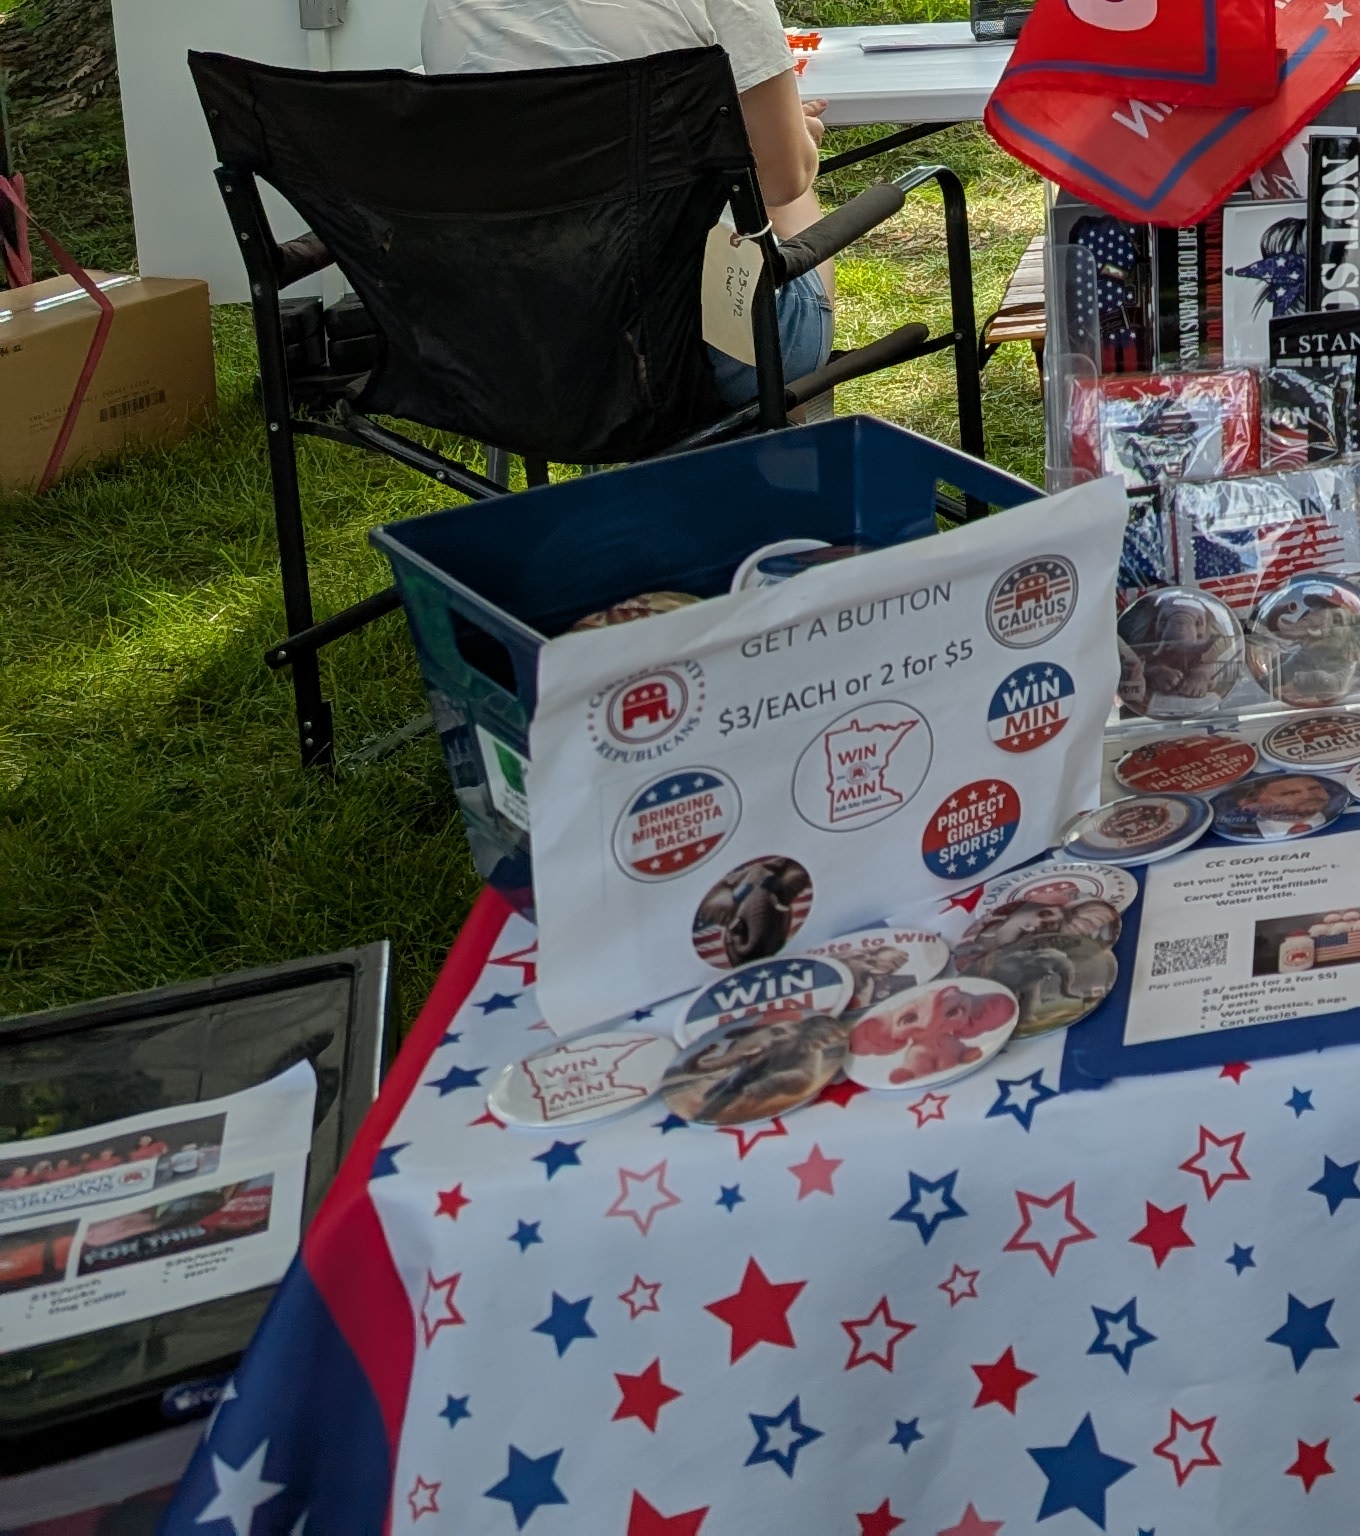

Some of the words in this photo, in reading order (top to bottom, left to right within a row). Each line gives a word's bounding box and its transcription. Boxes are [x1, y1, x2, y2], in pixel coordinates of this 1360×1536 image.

[1279, 336, 1287, 355] I
[741, 624, 799, 658] GET
[808, 617, 827, 642] A
[837, 581, 952, 633] BUTTON
[997, 597, 1067, 632] CAUCUS
[719, 679, 836, 736] $3/EACH
[846, 674, 872, 696] or
[880, 663, 895, 686] 2
[903, 653, 937, 679] for
[945, 638, 973, 668] $5
[1002, 677, 1060, 712] WIN
[1005, 702, 1060, 738] MIN
[838, 744, 877, 765] WIN
[1170, 761, 1202, 774] can
[1204, 753, 1227, 763] no
[836, 781, 876, 804] MIN
[631, 806, 724, 845] MINNESOTA
[637, 793, 714, 828] BRINGING
[937, 793, 1006, 832] PROTECT
[655, 825, 702, 850] BACK!
[938, 827, 1004, 865] SPORTS!
[946, 813, 997, 844] GIRLS'
[1206, 860, 1227, 869] CC
[1230, 856, 1264, 866] GOP
[1268, 851, 1311, 862] GEAR
[714, 969, 814, 1010] WIN
[549, 1082, 605, 1105] MIN
